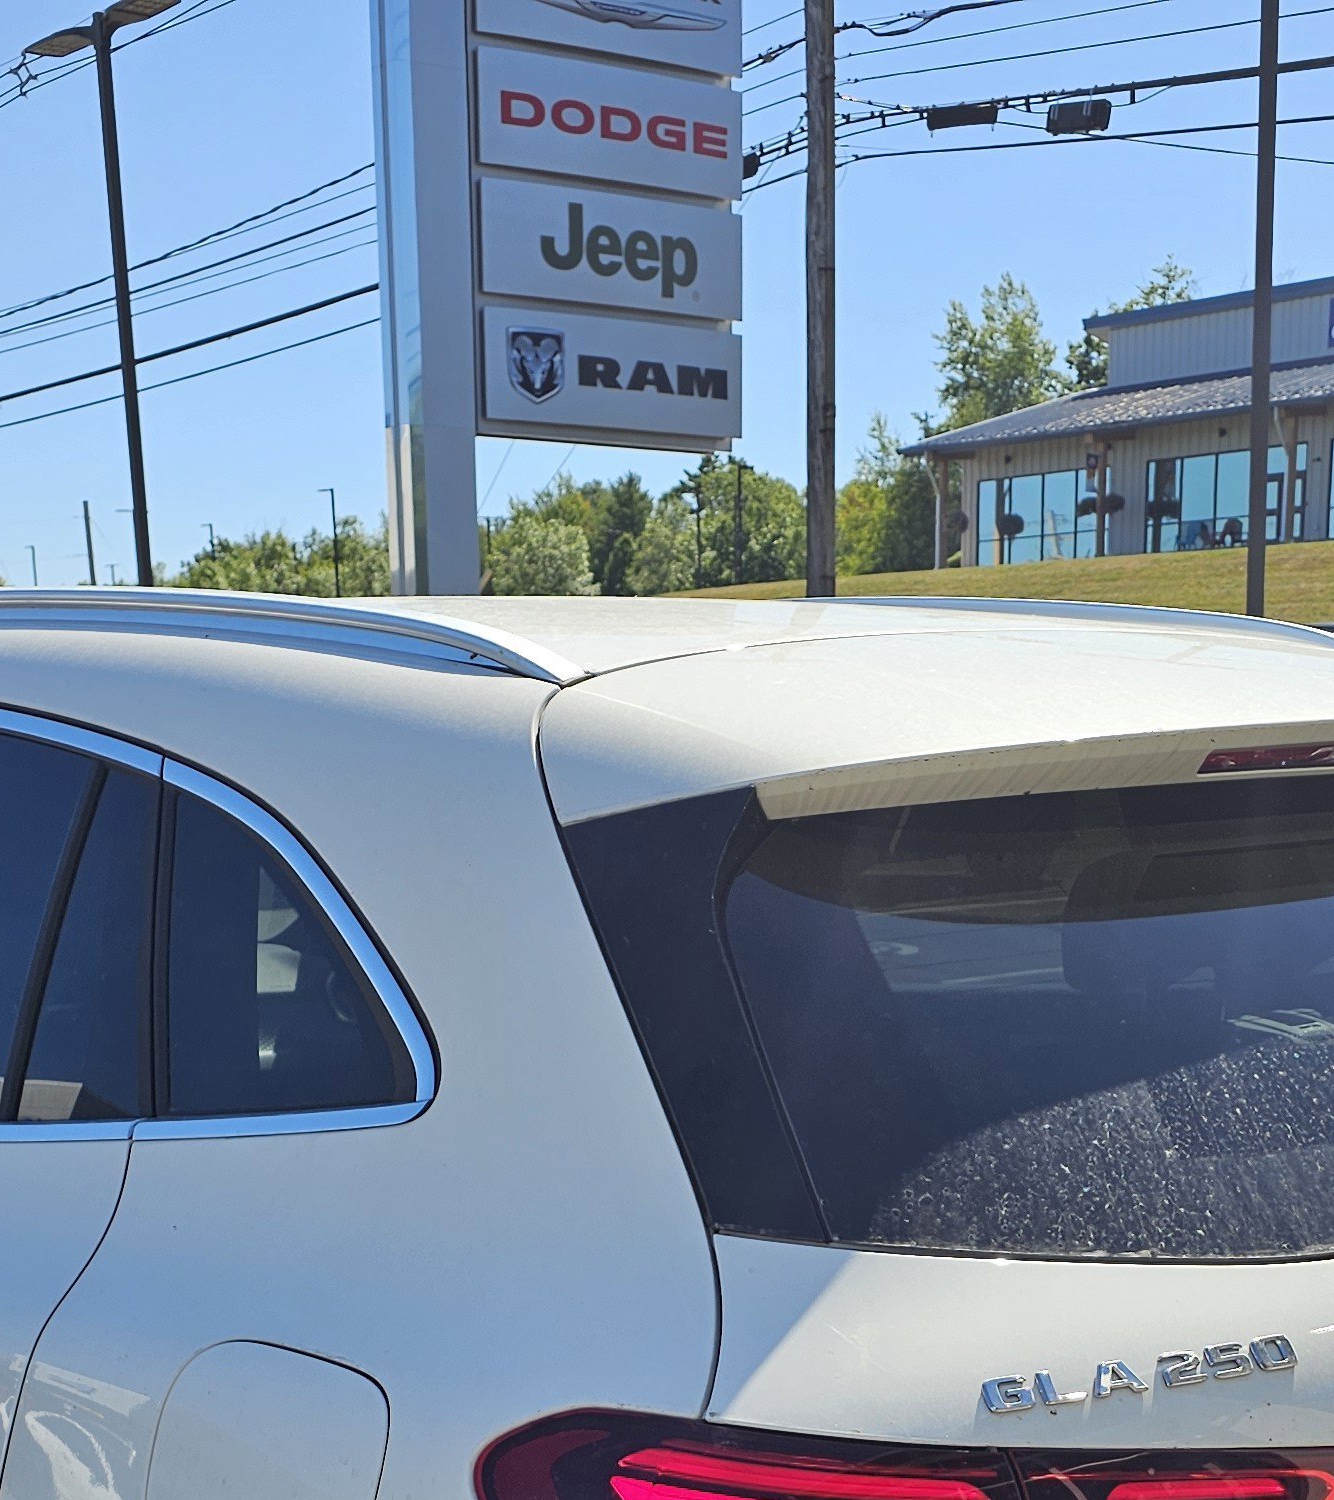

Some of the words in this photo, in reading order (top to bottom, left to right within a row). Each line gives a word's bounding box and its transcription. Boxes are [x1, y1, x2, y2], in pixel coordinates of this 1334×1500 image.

[500, 90, 728, 159] DODGE
[540, 201, 698, 298] Jeep
[577, 354, 728, 400] RAM
[980, 1359, 1150, 1414] GLA
[1156, 1333, 1299, 1388] 250
